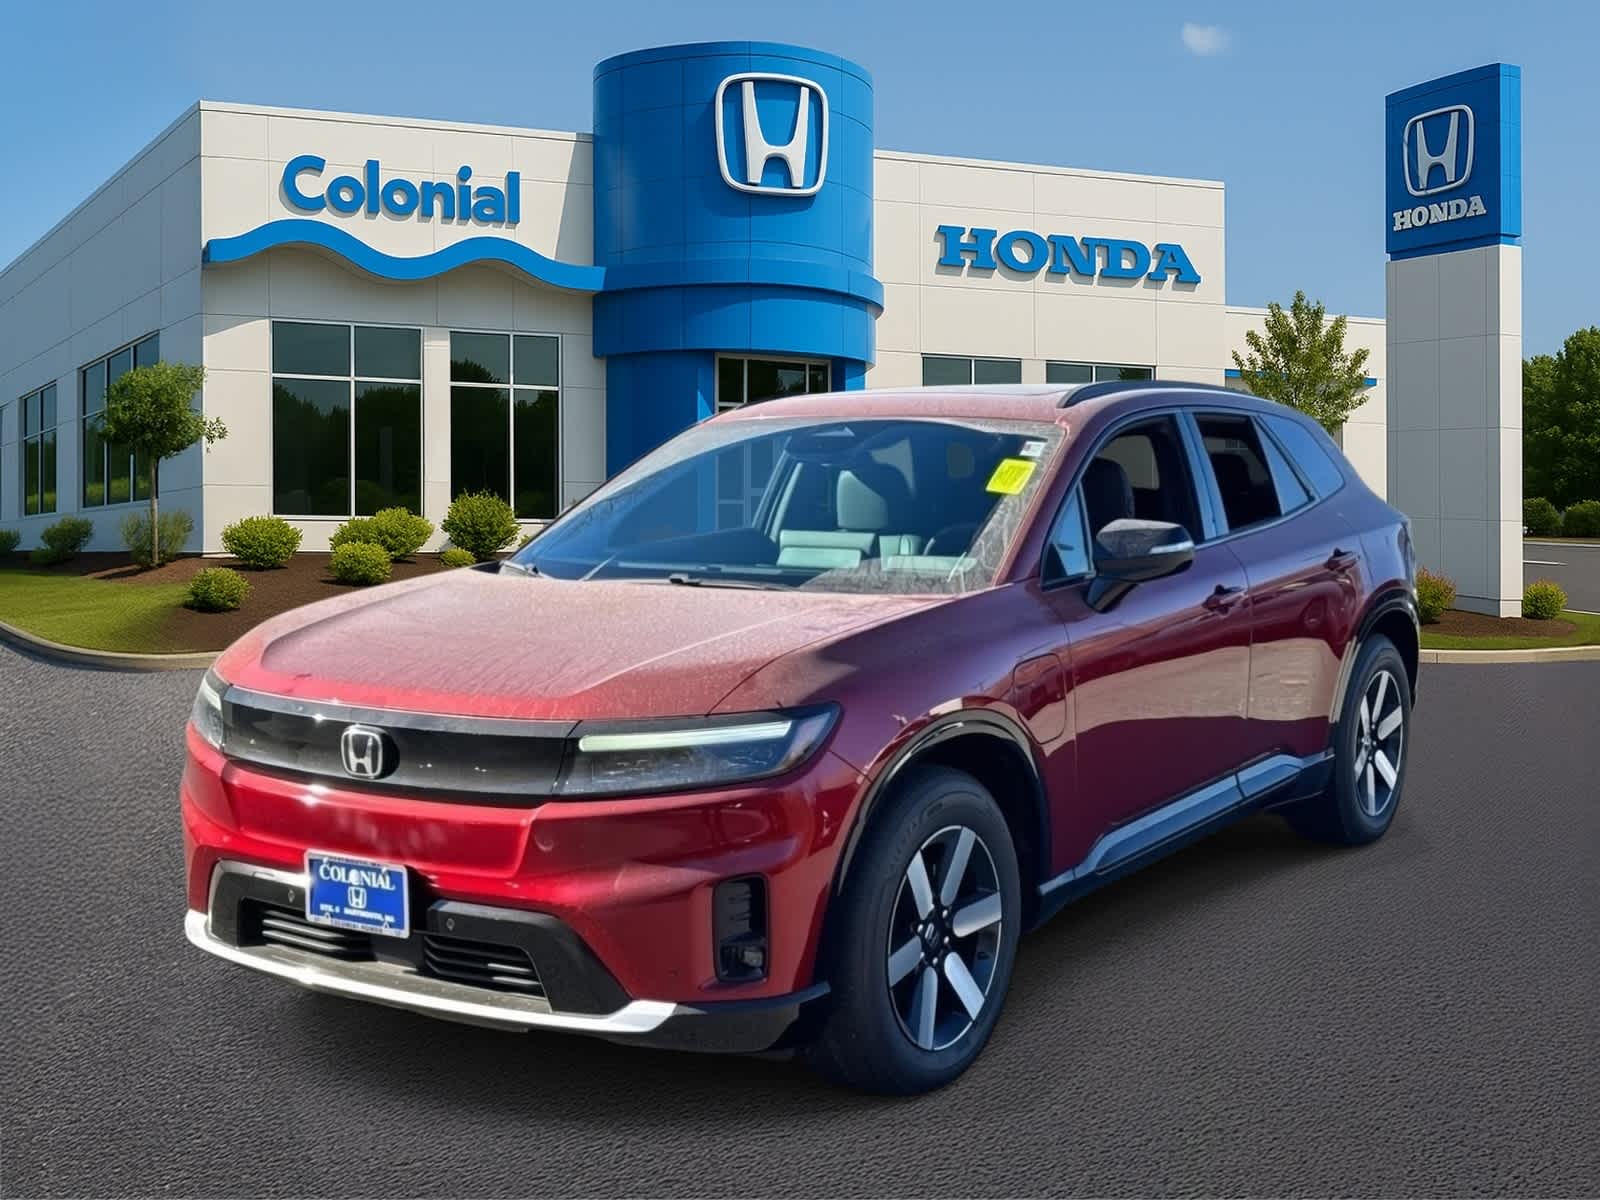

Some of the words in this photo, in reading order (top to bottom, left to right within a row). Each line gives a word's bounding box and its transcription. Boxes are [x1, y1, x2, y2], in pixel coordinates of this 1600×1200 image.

[281, 154, 521, 225] Colonial
[1392, 195, 1487, 232] HONDA
[936, 224, 1202, 285] HONDA
[319, 862, 396, 891] COLONIAL
